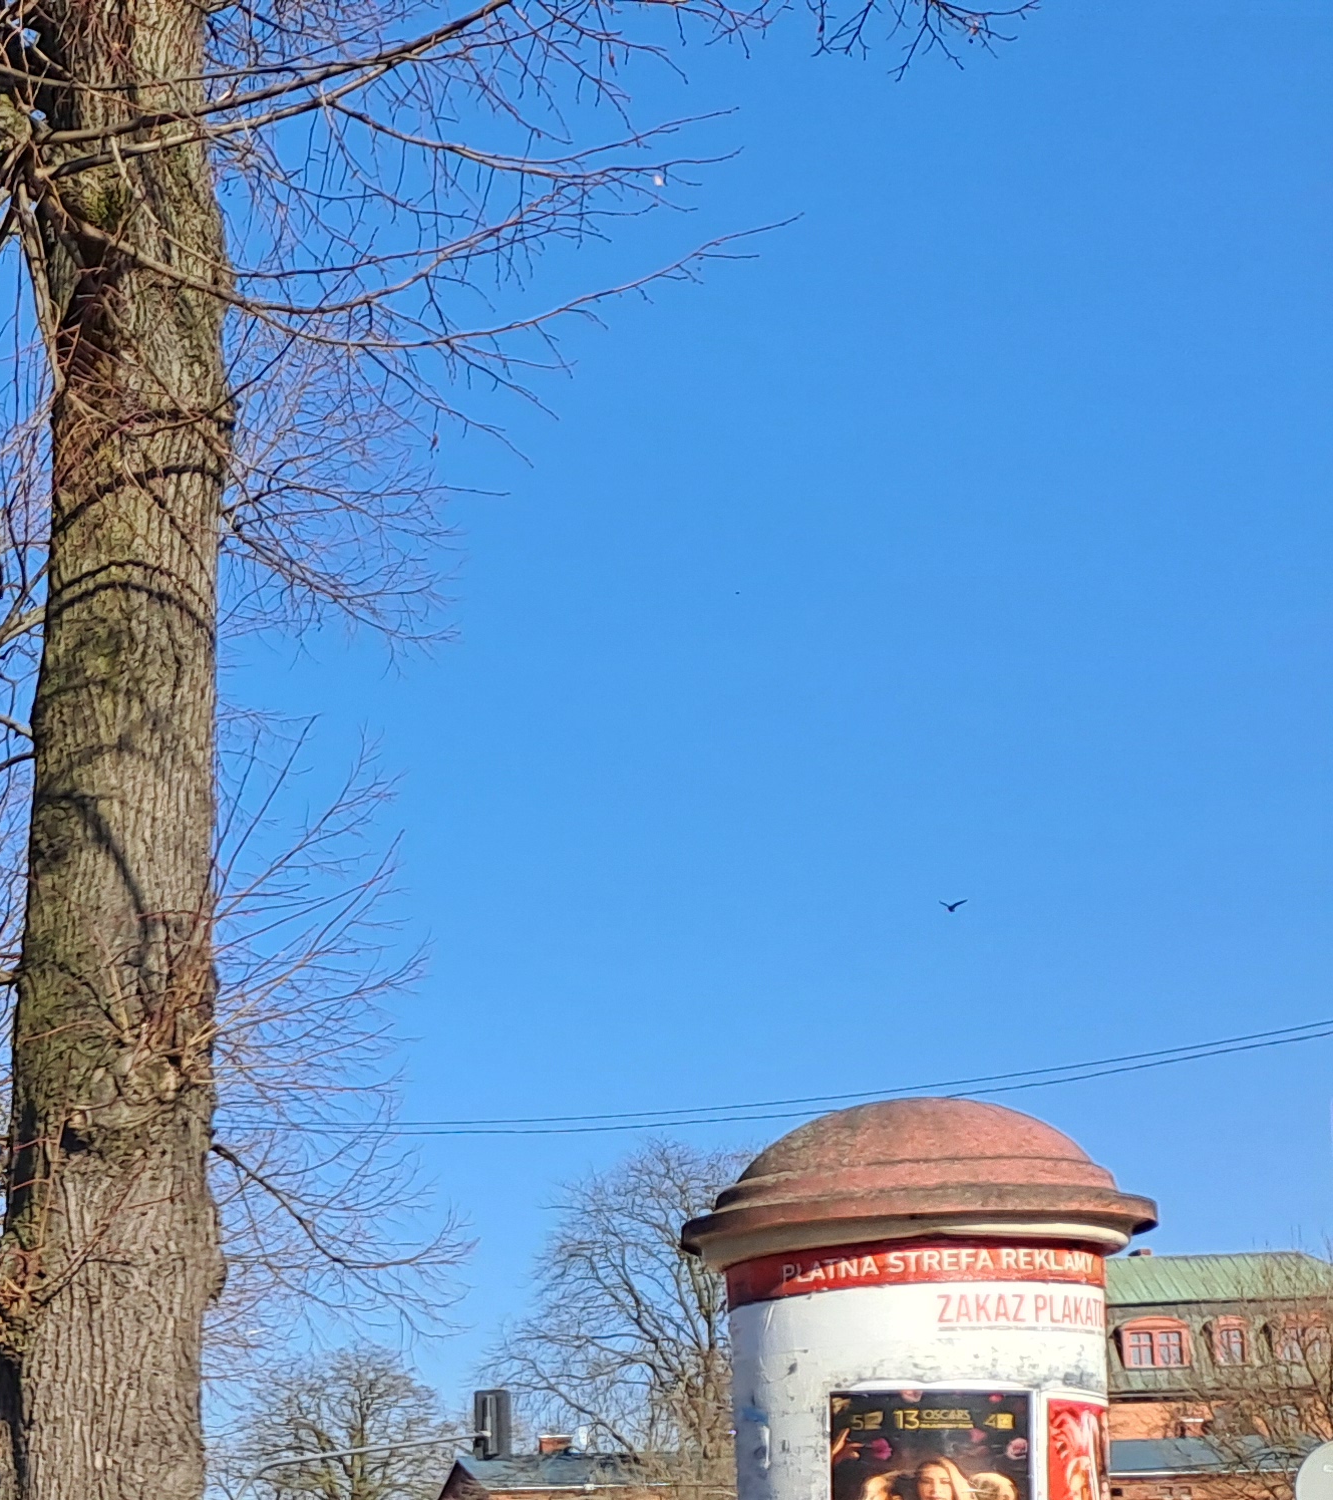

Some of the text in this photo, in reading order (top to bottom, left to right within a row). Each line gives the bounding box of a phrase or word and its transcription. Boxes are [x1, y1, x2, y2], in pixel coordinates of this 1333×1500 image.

[783, 1248, 1095, 1283] PŁATNA STREFA REKLAMY
[937, 1293, 1027, 1322] ZAKAZ
[893, 1408, 920, 1430] 13
